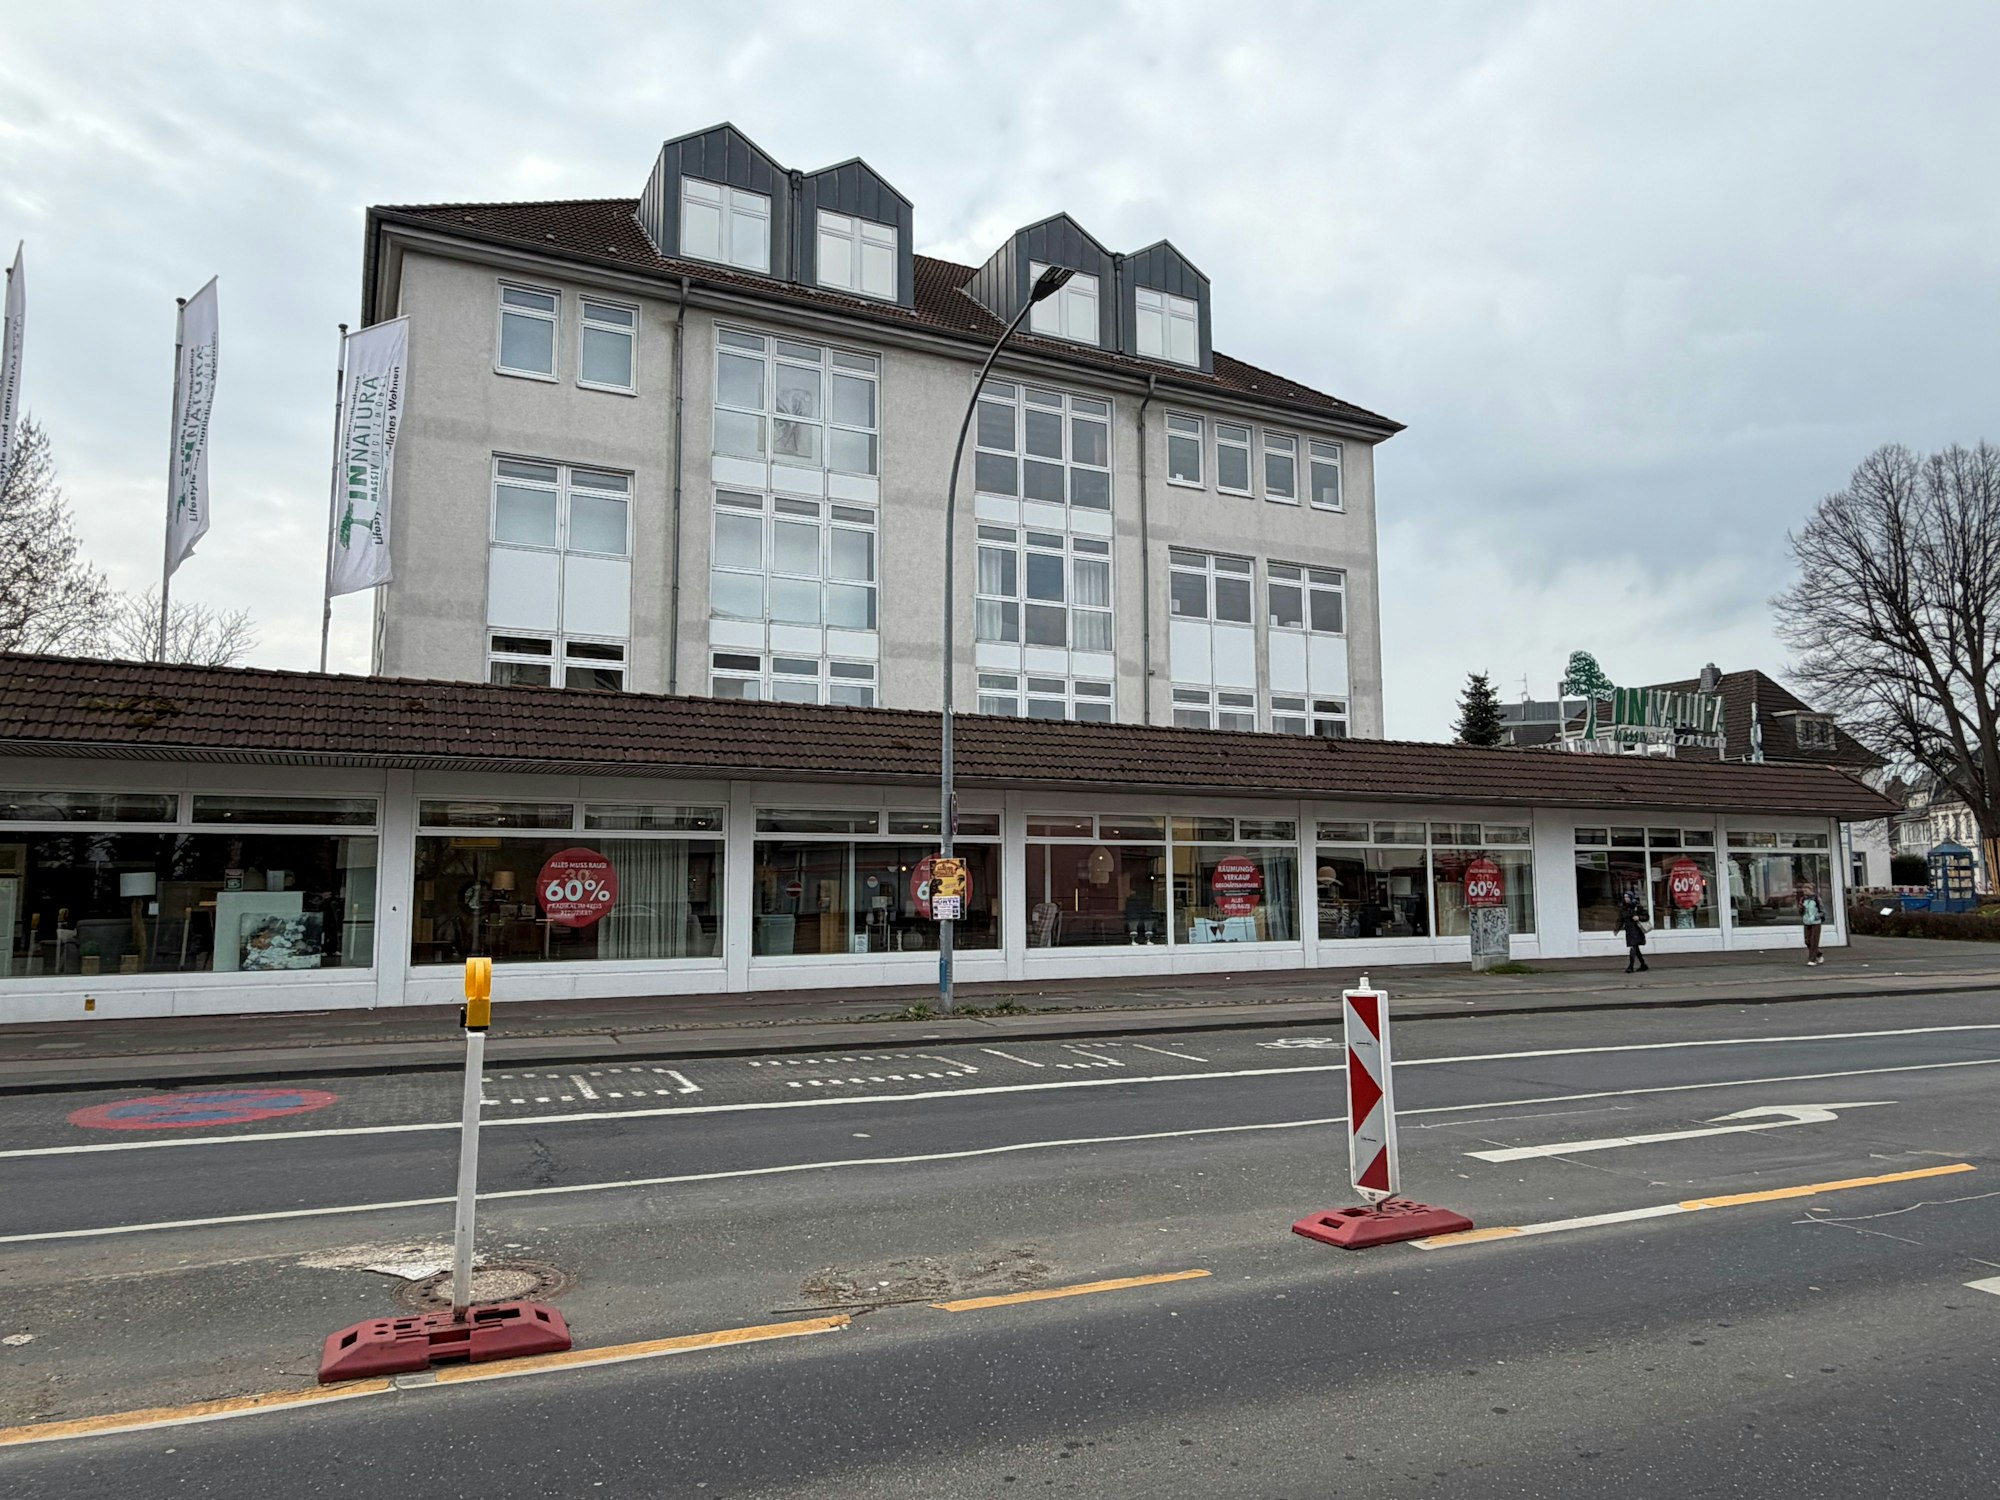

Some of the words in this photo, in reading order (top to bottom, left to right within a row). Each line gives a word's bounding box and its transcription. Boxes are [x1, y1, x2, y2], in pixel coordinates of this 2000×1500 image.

[387, 366, 400, 411] Wohnen
[348, 376, 379, 501] INNATURA
[188, 474, 198, 522] Lifestyle
[545, 880, 610, 902] 60%
[1468, 881, 1500, 896] 60%
[1673, 878, 1700, 892] 60%
